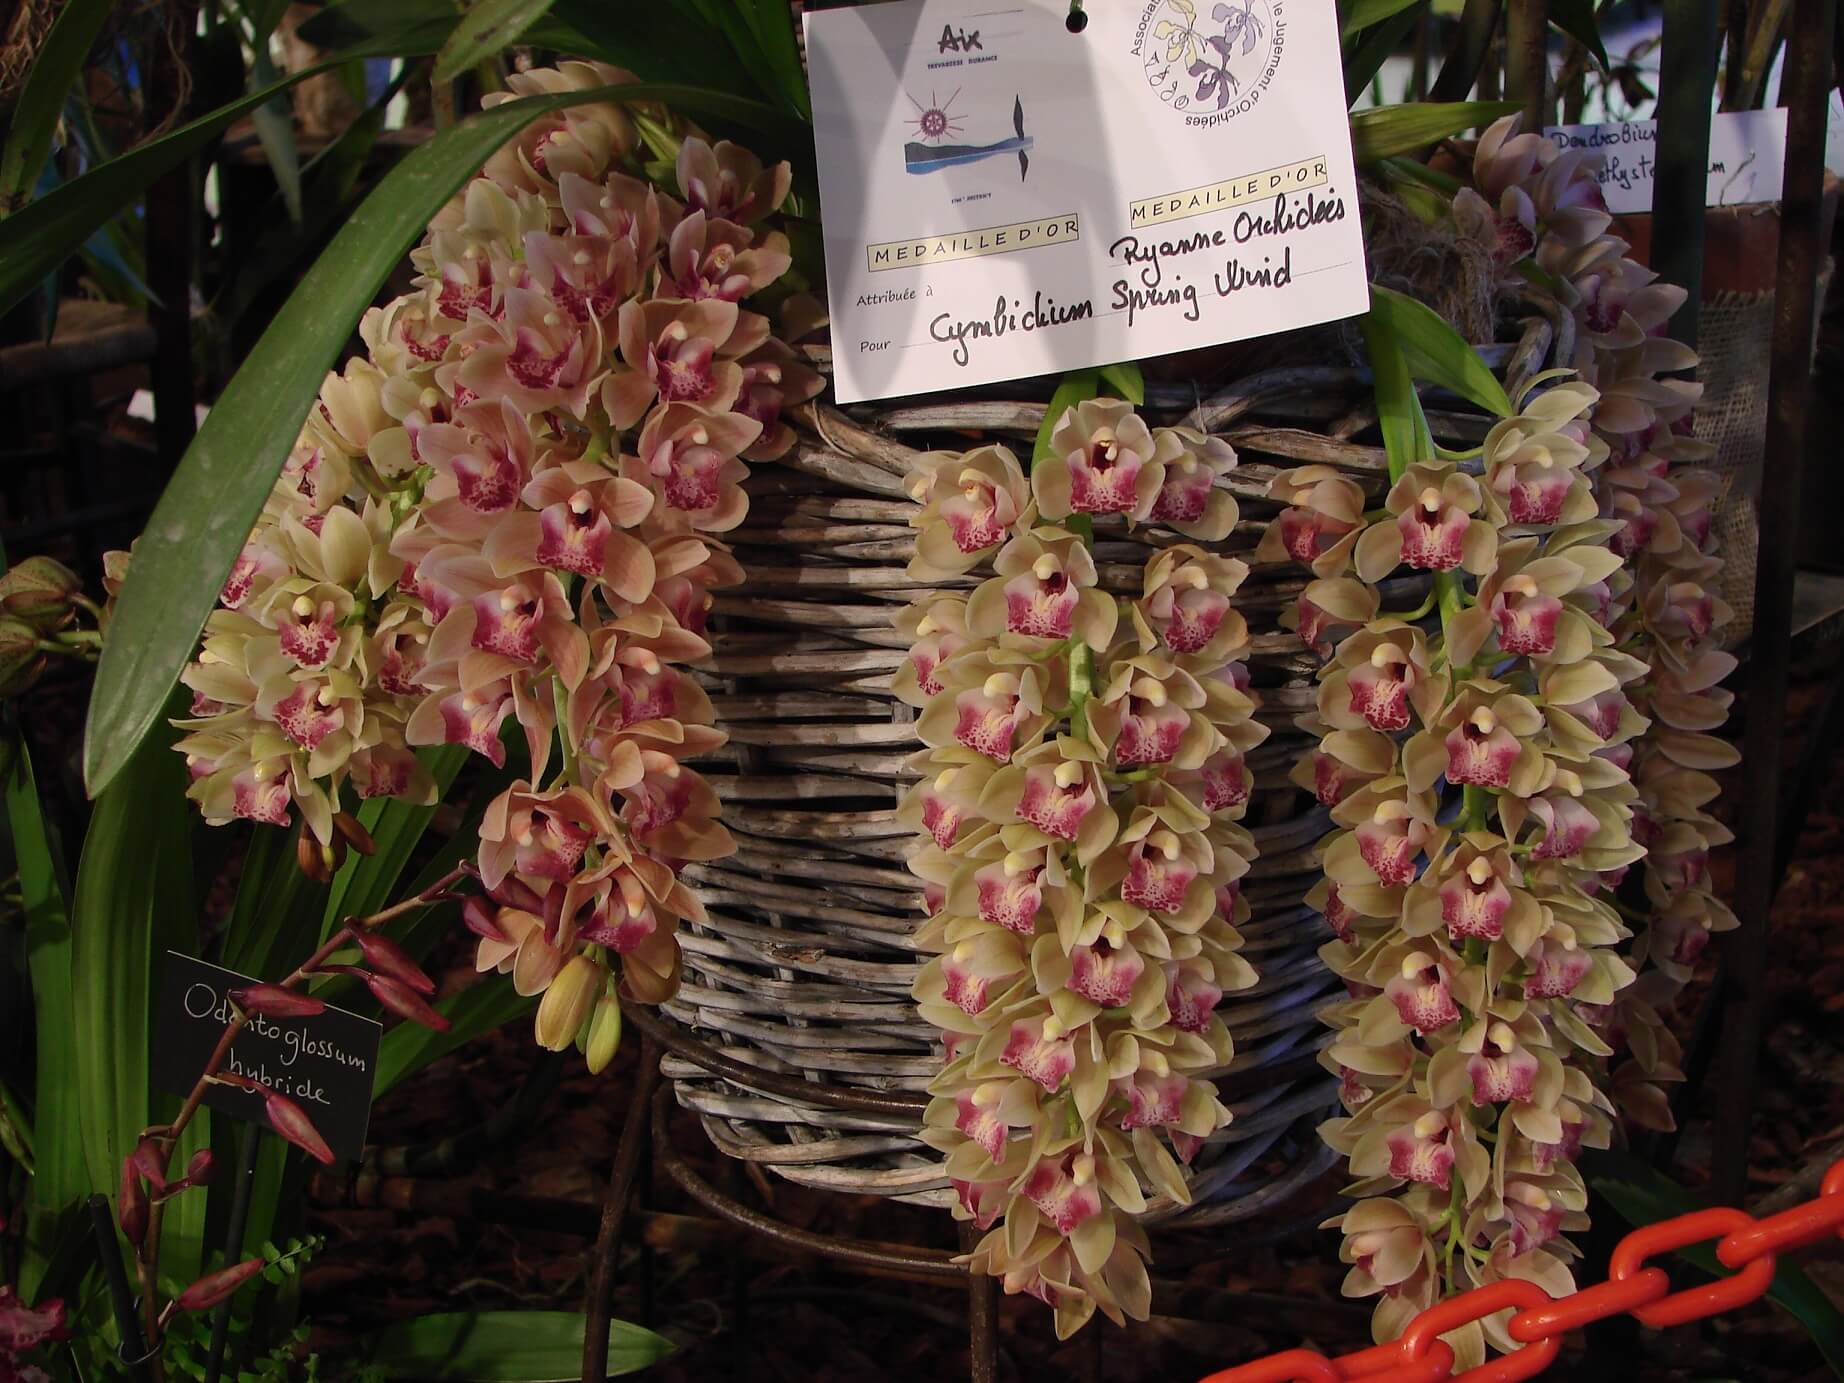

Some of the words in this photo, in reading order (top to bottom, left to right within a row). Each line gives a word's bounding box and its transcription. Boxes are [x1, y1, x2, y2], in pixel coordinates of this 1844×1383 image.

[937, 24, 983, 54] Aix
[1258, 20, 1287, 91] Jugement
[1185, 90, 1260, 129] d'Orchidées
[1132, 179, 1258, 222] MEDAILLE
[1269, 162, 1327, 188] D'OR
[874, 231, 1007, 264] MEDAILLE
[1018, 220, 1078, 241] D'OR
[856, 287, 917, 307] Attribuée
[925, 284, 934, 297] à
[929, 290, 1093, 367] Cymbidium
[1111, 274, 1200, 328] Spring
[1214, 246, 1292, 297] Wind
[859, 339, 891, 353] Pour
[229, 1047, 331, 1105] hybride
